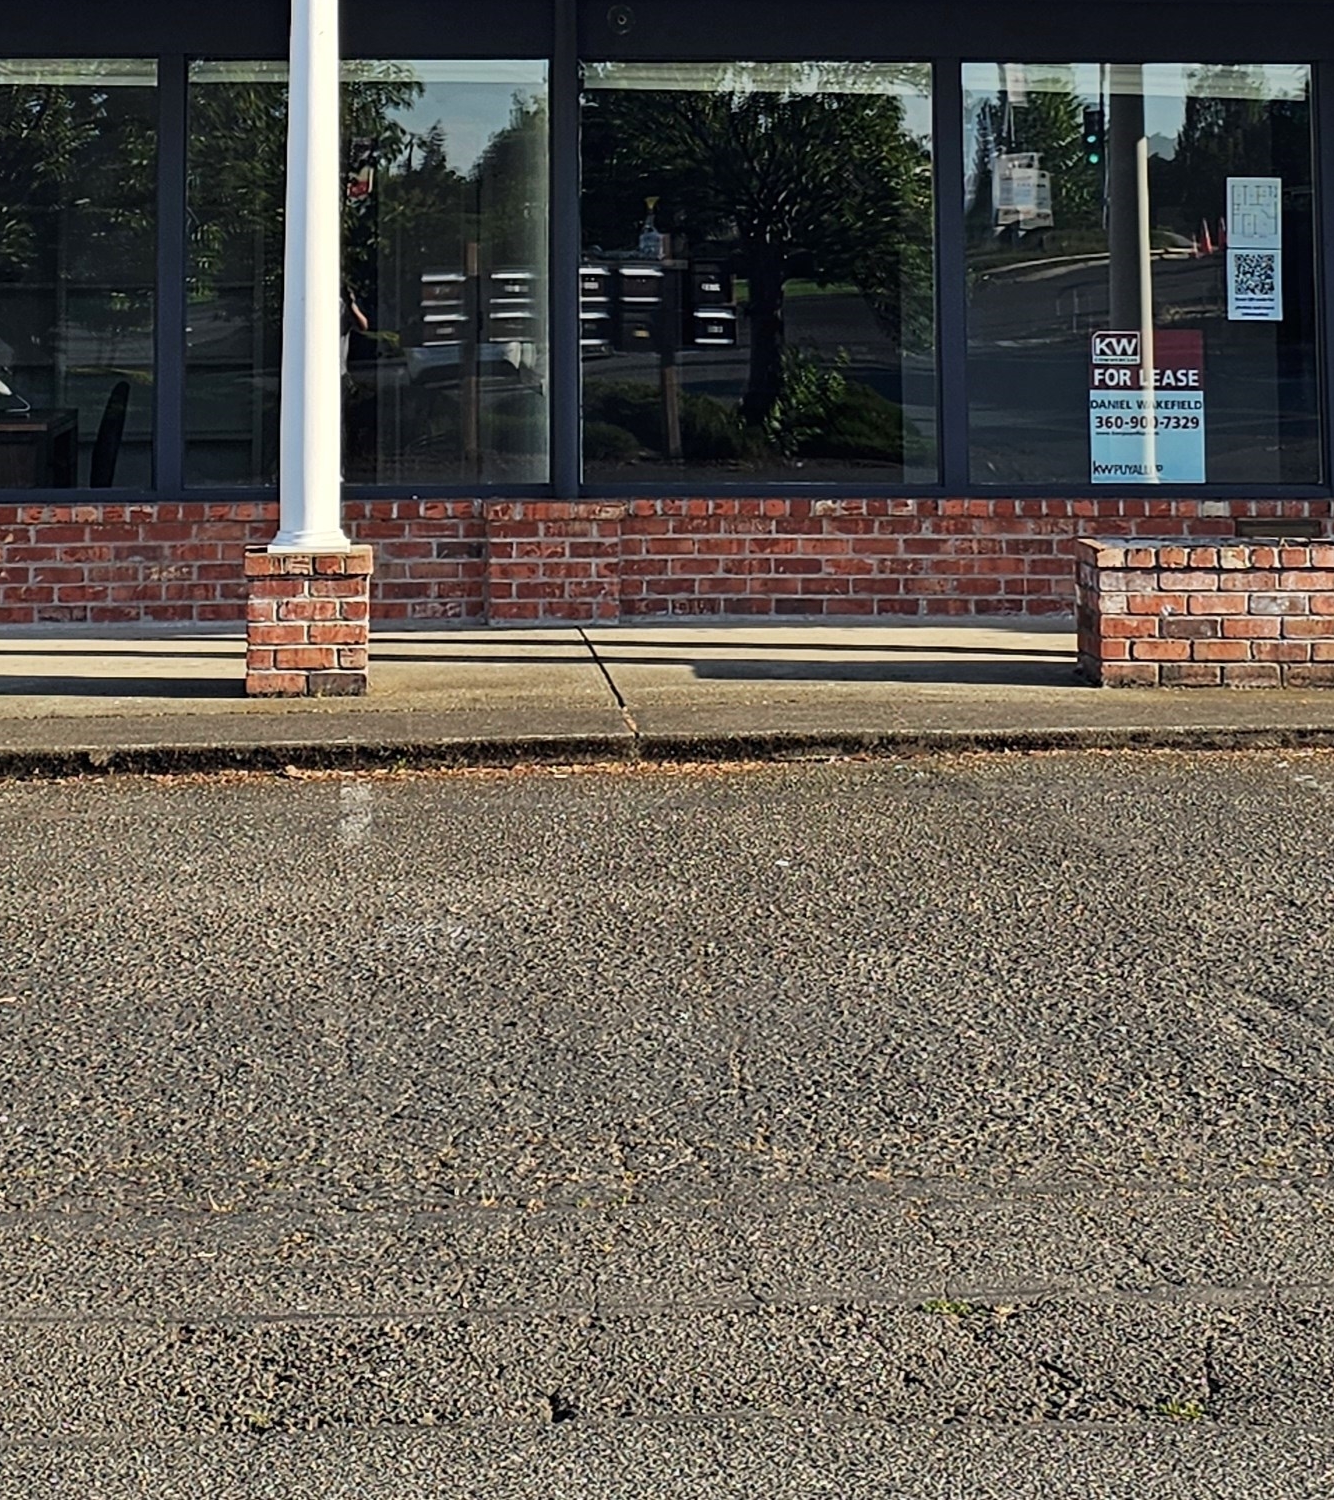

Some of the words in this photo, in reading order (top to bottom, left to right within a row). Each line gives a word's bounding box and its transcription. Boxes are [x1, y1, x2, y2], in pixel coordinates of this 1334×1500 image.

[1094, 338, 1137, 355] KW
[1093, 368, 1131, 386] FOR
[1139, 369, 1200, 387] LEASE
[1090, 400, 1132, 409] DANIEL
[1095, 415, 1199, 430] 360-900-7329
[1112, 464, 1164, 476] PUYALLP
